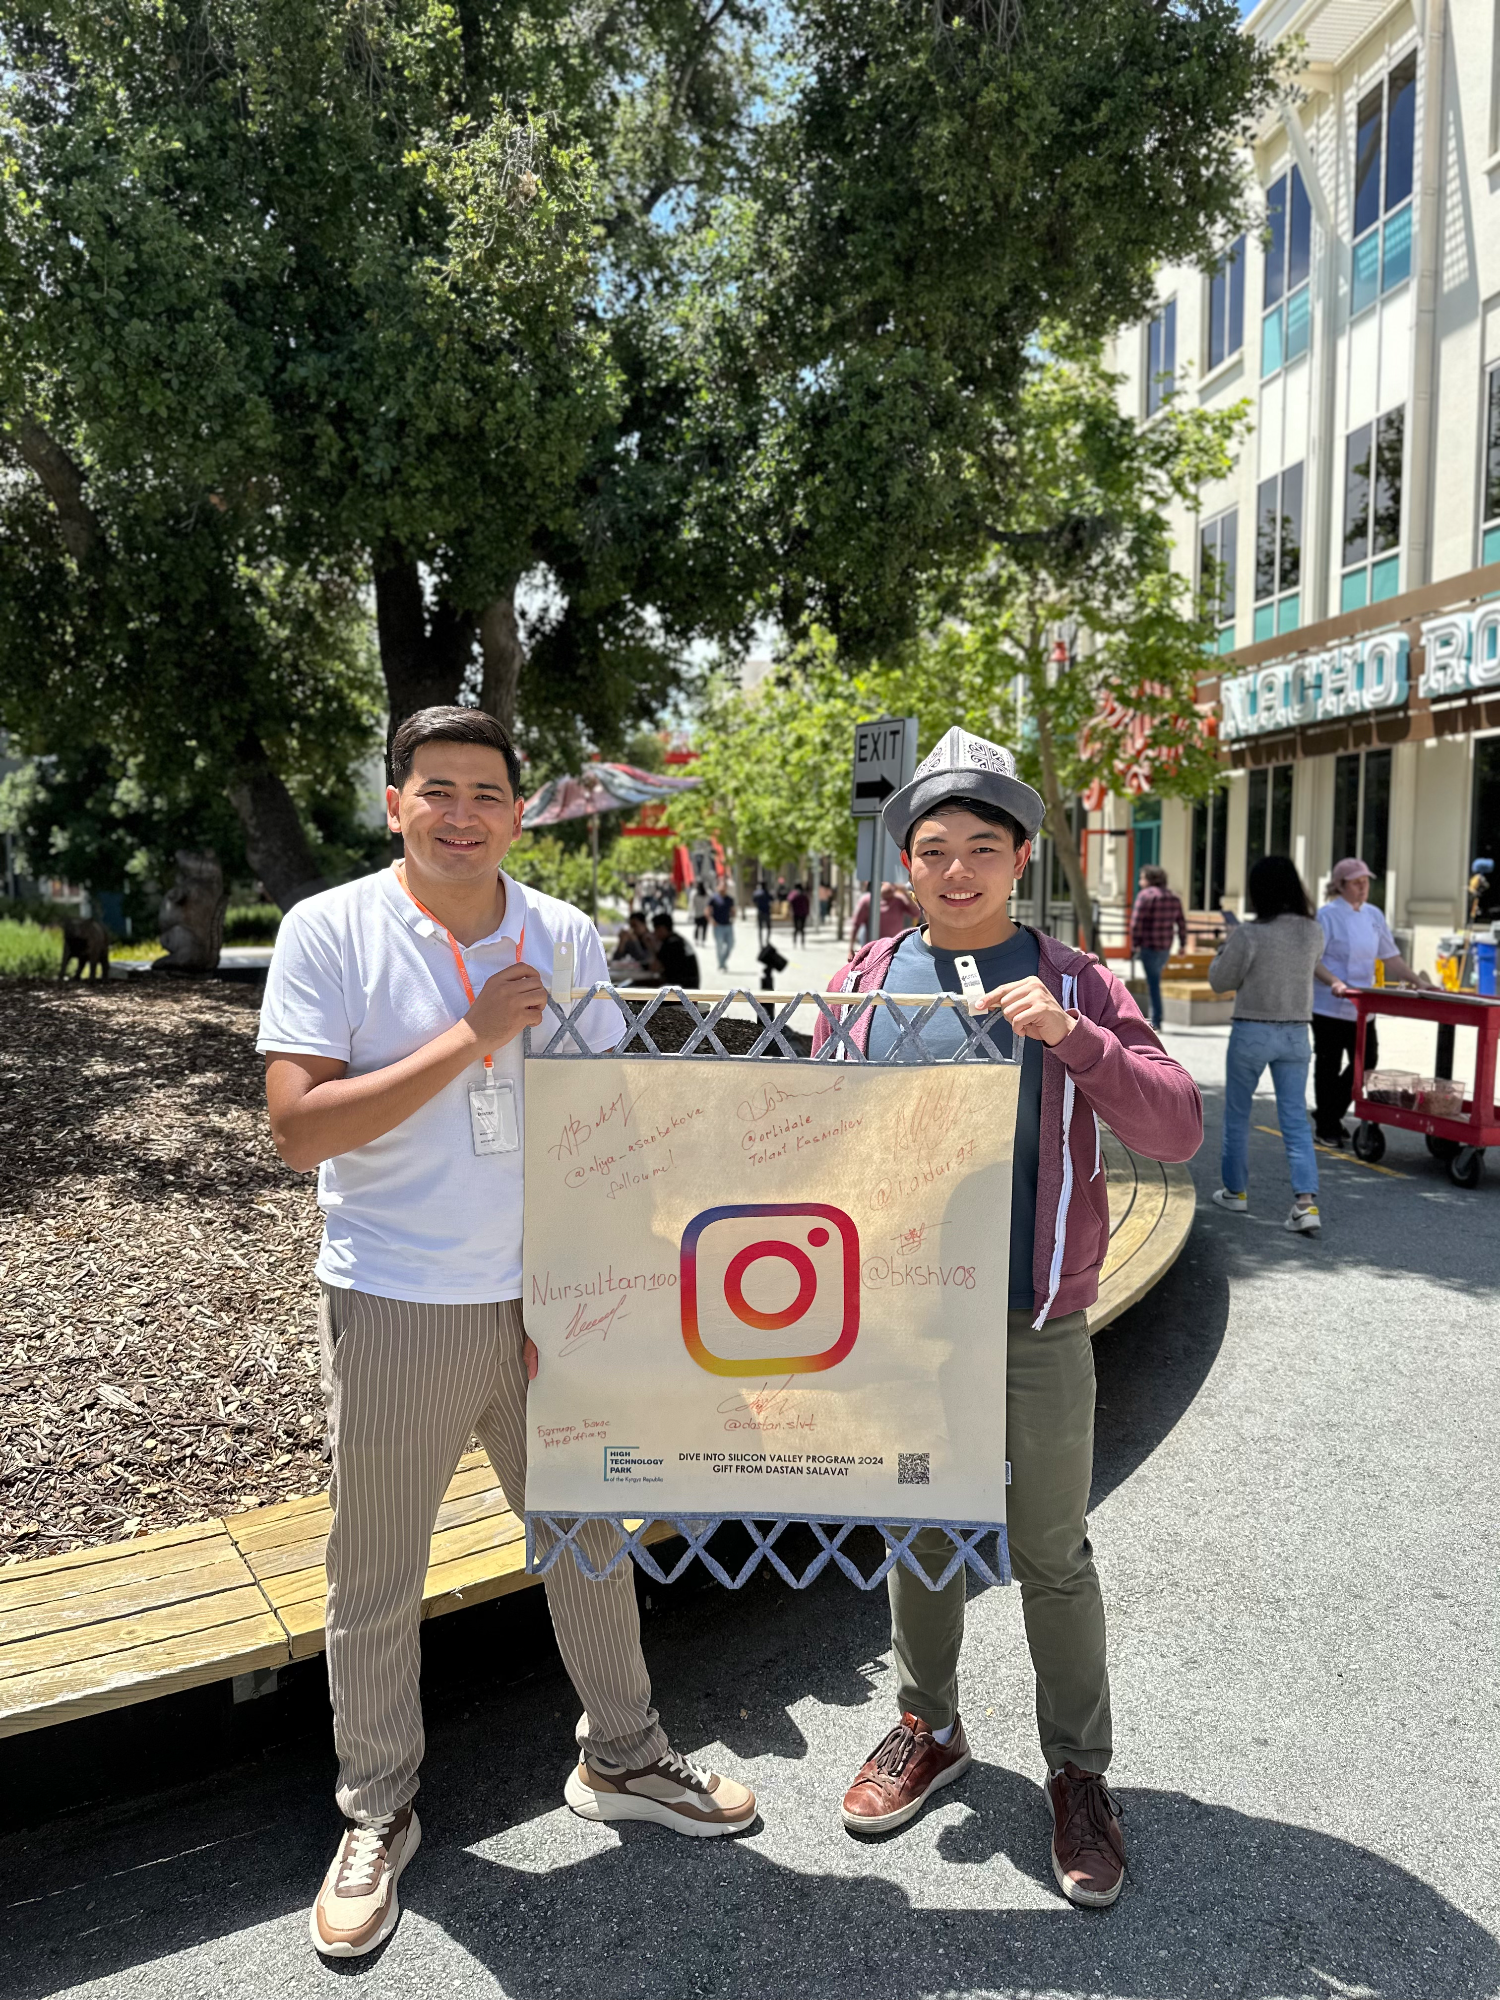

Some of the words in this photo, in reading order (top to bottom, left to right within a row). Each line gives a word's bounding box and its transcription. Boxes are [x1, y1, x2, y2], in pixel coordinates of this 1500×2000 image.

[1219, 631, 1410, 741] NACHO
[858, 729, 901, 763] EXIT
[678, 1453, 701, 1461] DIVE
[703, 1453, 726, 1461] INTO
[728, 1453, 767, 1462] SILICON
[769, 1454, 803, 1463] VALLEY
[806, 1455, 856, 1465] PROGRAM
[858, 1456, 884, 1465] 2024
[610, 1466, 632, 1474] PARK
[712, 1464, 733, 1473] GIFT
[735, 1465, 763, 1474] FROM
[765, 1465, 804, 1475] DASTAN
[806, 1466, 849, 1476] SALAVAT
